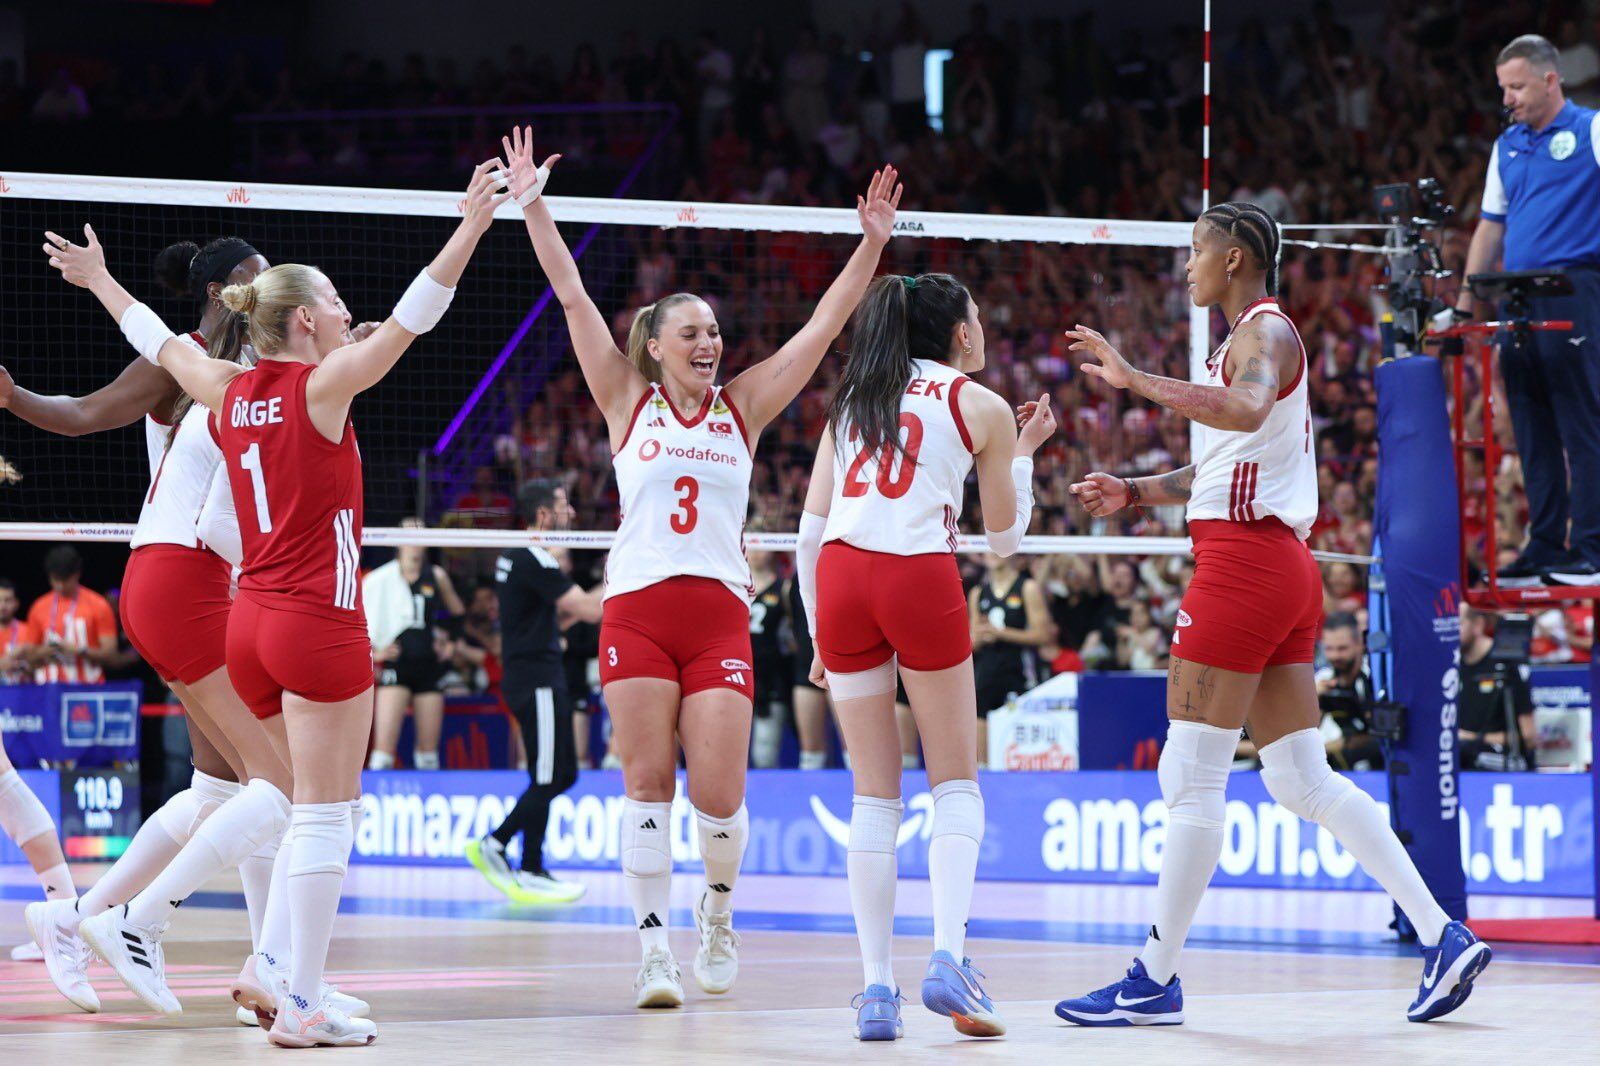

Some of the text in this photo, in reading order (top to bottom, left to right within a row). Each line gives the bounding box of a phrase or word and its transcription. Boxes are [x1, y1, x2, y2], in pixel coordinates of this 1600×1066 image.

[892, 221, 925, 232] KASA
[231, 396, 284, 428] ÖRGE
[666, 446, 737, 467] vodafone
[842, 411, 924, 500] 20
[240, 442, 273, 534] 1
[669, 476, 699, 535] 3
[607, 646, 618, 667] 3
[1438, 702, 1460, 820] Senoh
